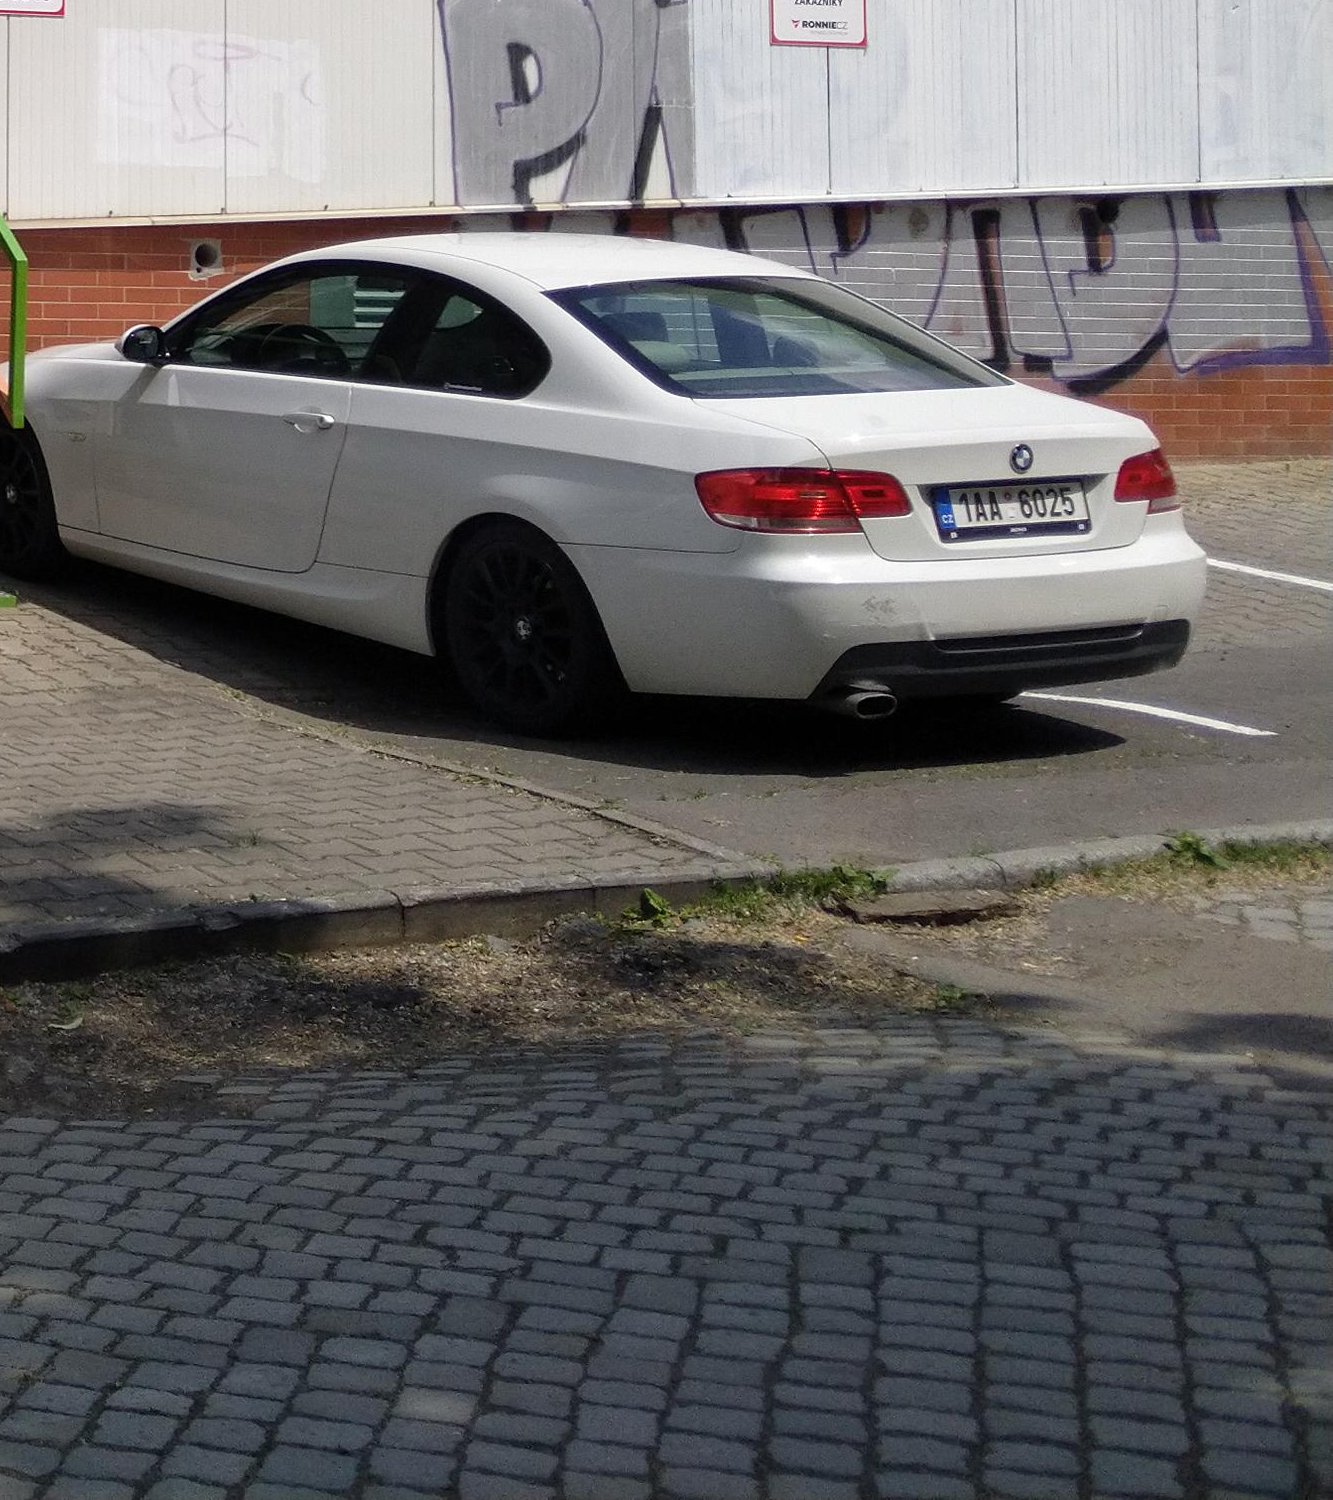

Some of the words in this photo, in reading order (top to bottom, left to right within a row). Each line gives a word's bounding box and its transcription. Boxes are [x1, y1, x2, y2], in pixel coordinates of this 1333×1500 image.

[959, 491, 1003, 523] 1AA
[1017, 487, 1075, 519] 6025
[941, 514, 954, 524] CZ
